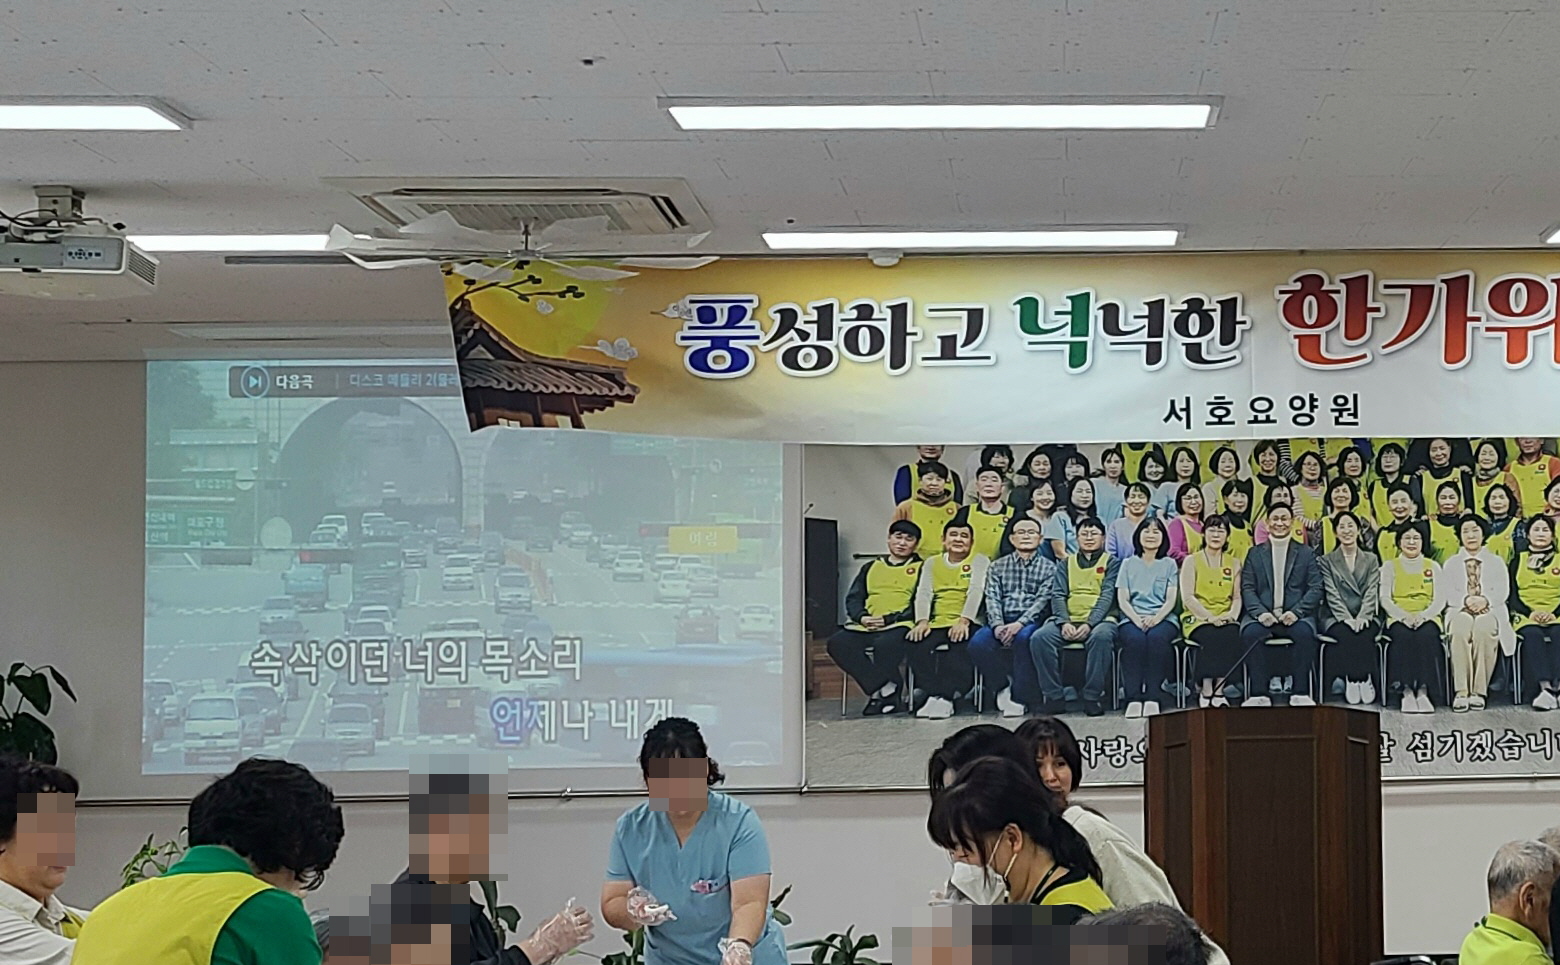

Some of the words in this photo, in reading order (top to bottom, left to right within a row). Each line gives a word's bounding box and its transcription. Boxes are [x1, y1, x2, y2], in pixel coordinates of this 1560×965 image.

[676, 292, 994, 377] 풍성하고
[1011, 287, 1249, 374] 넉넉한
[275, 374, 315, 390] 다음곡
[1163, 391, 1361, 429] 서호요양원
[249, 638, 391, 685] 속삭이던
[402, 637, 468, 683] 너의
[481, 636, 584, 681] 목소리
[490, 697, 595, 743] 언제나
